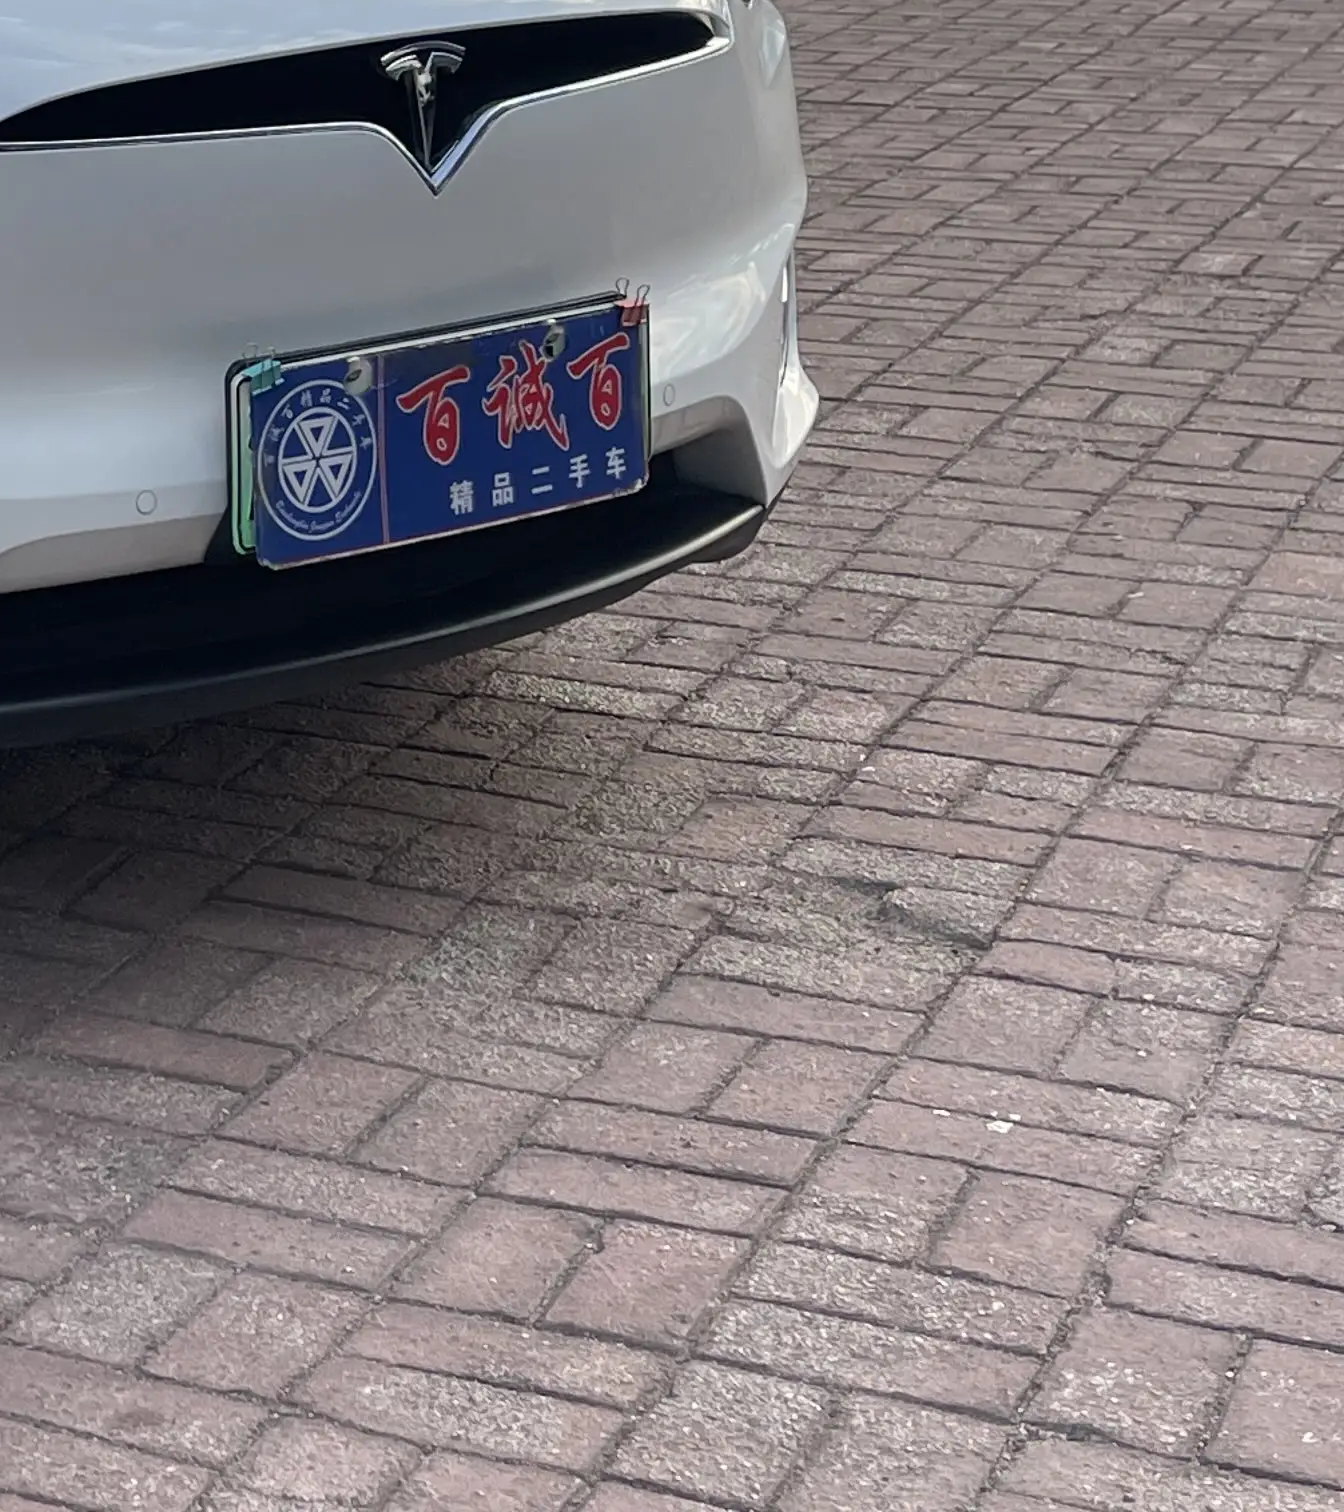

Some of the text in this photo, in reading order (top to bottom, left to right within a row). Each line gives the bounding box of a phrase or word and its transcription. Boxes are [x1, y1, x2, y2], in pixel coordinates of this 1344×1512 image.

[396, 332, 631, 466] 百诚百
[449, 446, 627, 516] 精品二手车
